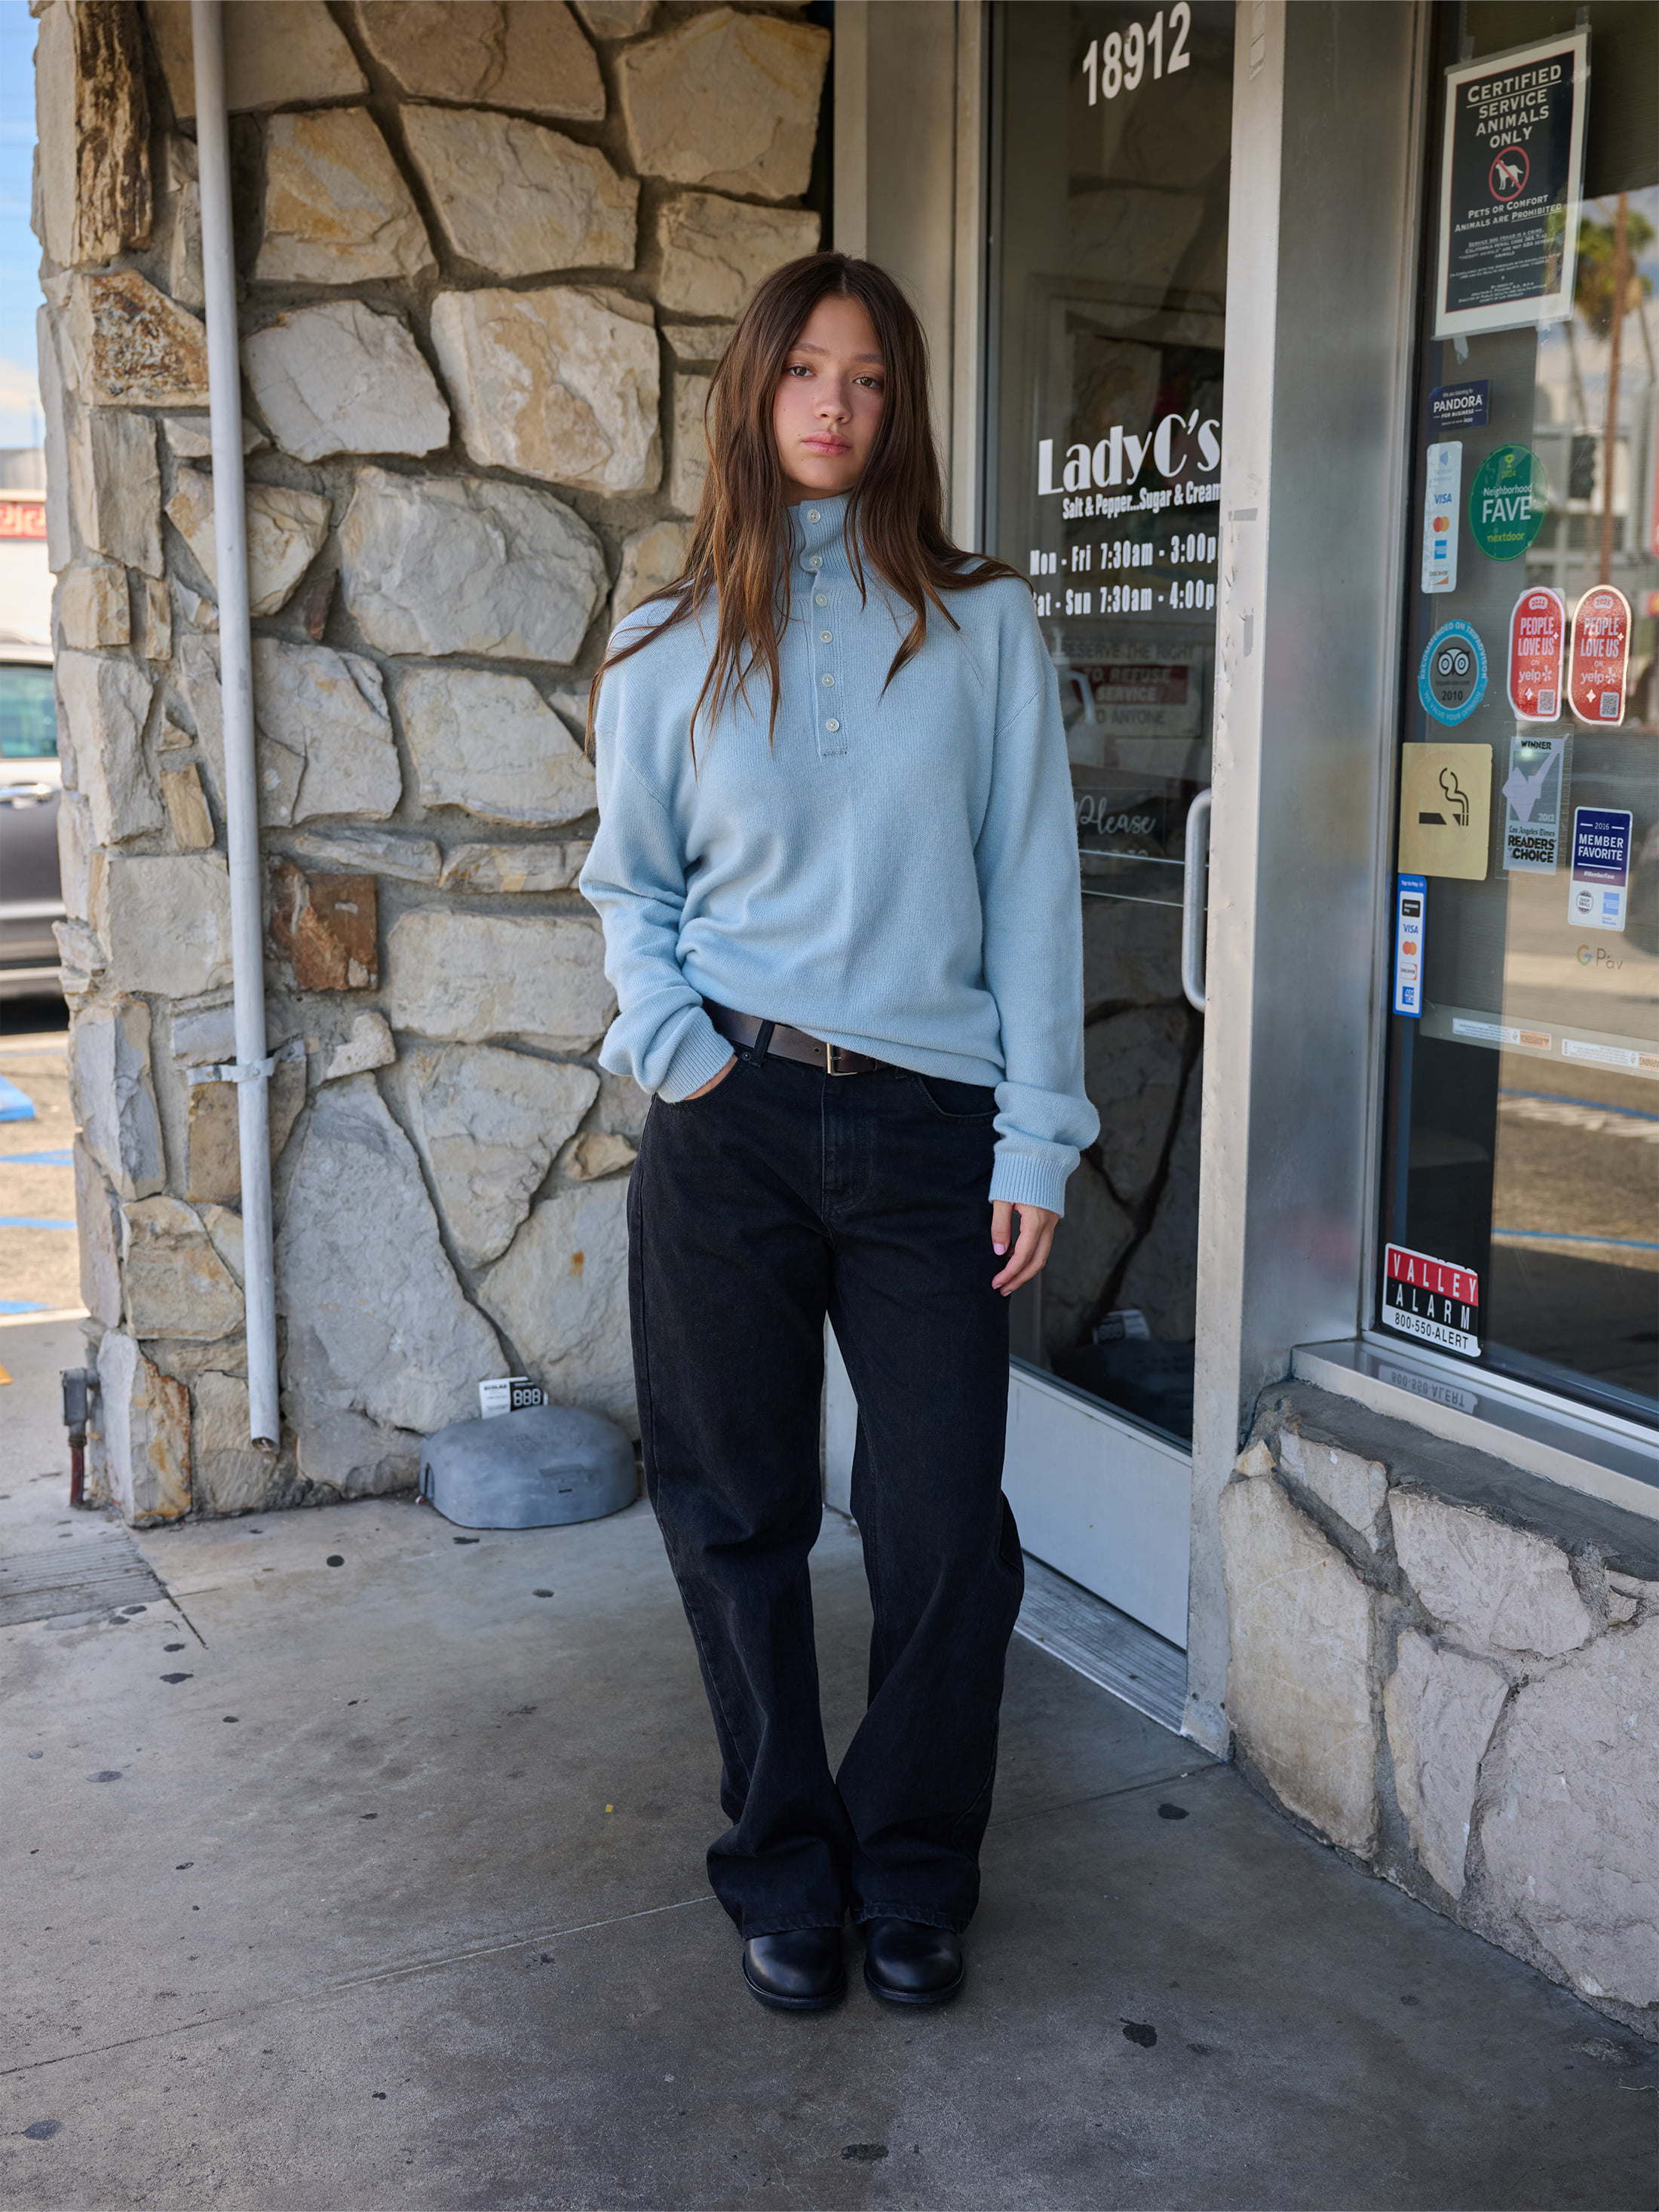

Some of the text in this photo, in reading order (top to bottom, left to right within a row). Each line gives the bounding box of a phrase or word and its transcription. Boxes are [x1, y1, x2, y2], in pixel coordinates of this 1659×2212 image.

[1083, 2, 1191, 106] 18912
[1467, 64, 1561, 103] CERTIFIED
[1479, 88, 1547, 119] SERVICE
[1476, 105, 1549, 137] ANIMALS
[1489, 127, 1533, 149] ONLY
[1467, 195, 1548, 219] PETS OR COMFORT
[1455, 204, 1562, 232] ANIMALS ARE PROHIBITED
[1433, 394, 1483, 413] PANDORA
[1063, 495, 1084, 519] Salt
[1085, 496, 1094, 516] &
[1174, 483, 1184, 506] &
[1185, 480, 1221, 504] Cream
[1434, 493, 1452, 504] VISA
[1483, 483, 1532, 498] Neighborhood
[1482, 495, 1532, 523] FAVE
[1487, 531, 1525, 543] nextdoor
[1030, 550, 1056, 575] Mon
[1072, 544, 1091, 572] Fri
[1101, 540, 1153, 569] 7:30am
[1170, 532, 1218, 564] 3:00p
[1066, 589, 1091, 615] Sun
[1099, 584, 1152, 614] 7:30am
[1170, 579, 1216, 611] 4:00p
[1520, 617, 1554, 636] PEOPLE
[1584, 617, 1619, 636] PEOPLE
[1421, 621, 1488, 679] RECOMMENDED ON TRIPADVISOR
[1518, 637, 1554, 657] LOVE US
[1581, 639, 1619, 657] LOVE US
[1110, 667, 1171, 682] REFUSE
[1519, 669, 1541, 683] yelp
[1581, 669, 1605, 685] yelp
[1096, 686, 1158, 702] SERVICE
[1442, 691, 1463, 701] 2010
[1521, 740, 1552, 750] WINNER
[1594, 822, 1609, 831] 2016
[1579, 833, 1624, 849] MEMBER
[1513, 847, 1553, 863] CHOICE
[1578, 846, 1623, 861] FAVORITE
[1403, 924, 1418, 934] VISA
[1394, 1253, 1476, 1302] VALLEY
[1396, 1283, 1470, 1330] ALARM
[513, 1388, 541, 1406] 888
